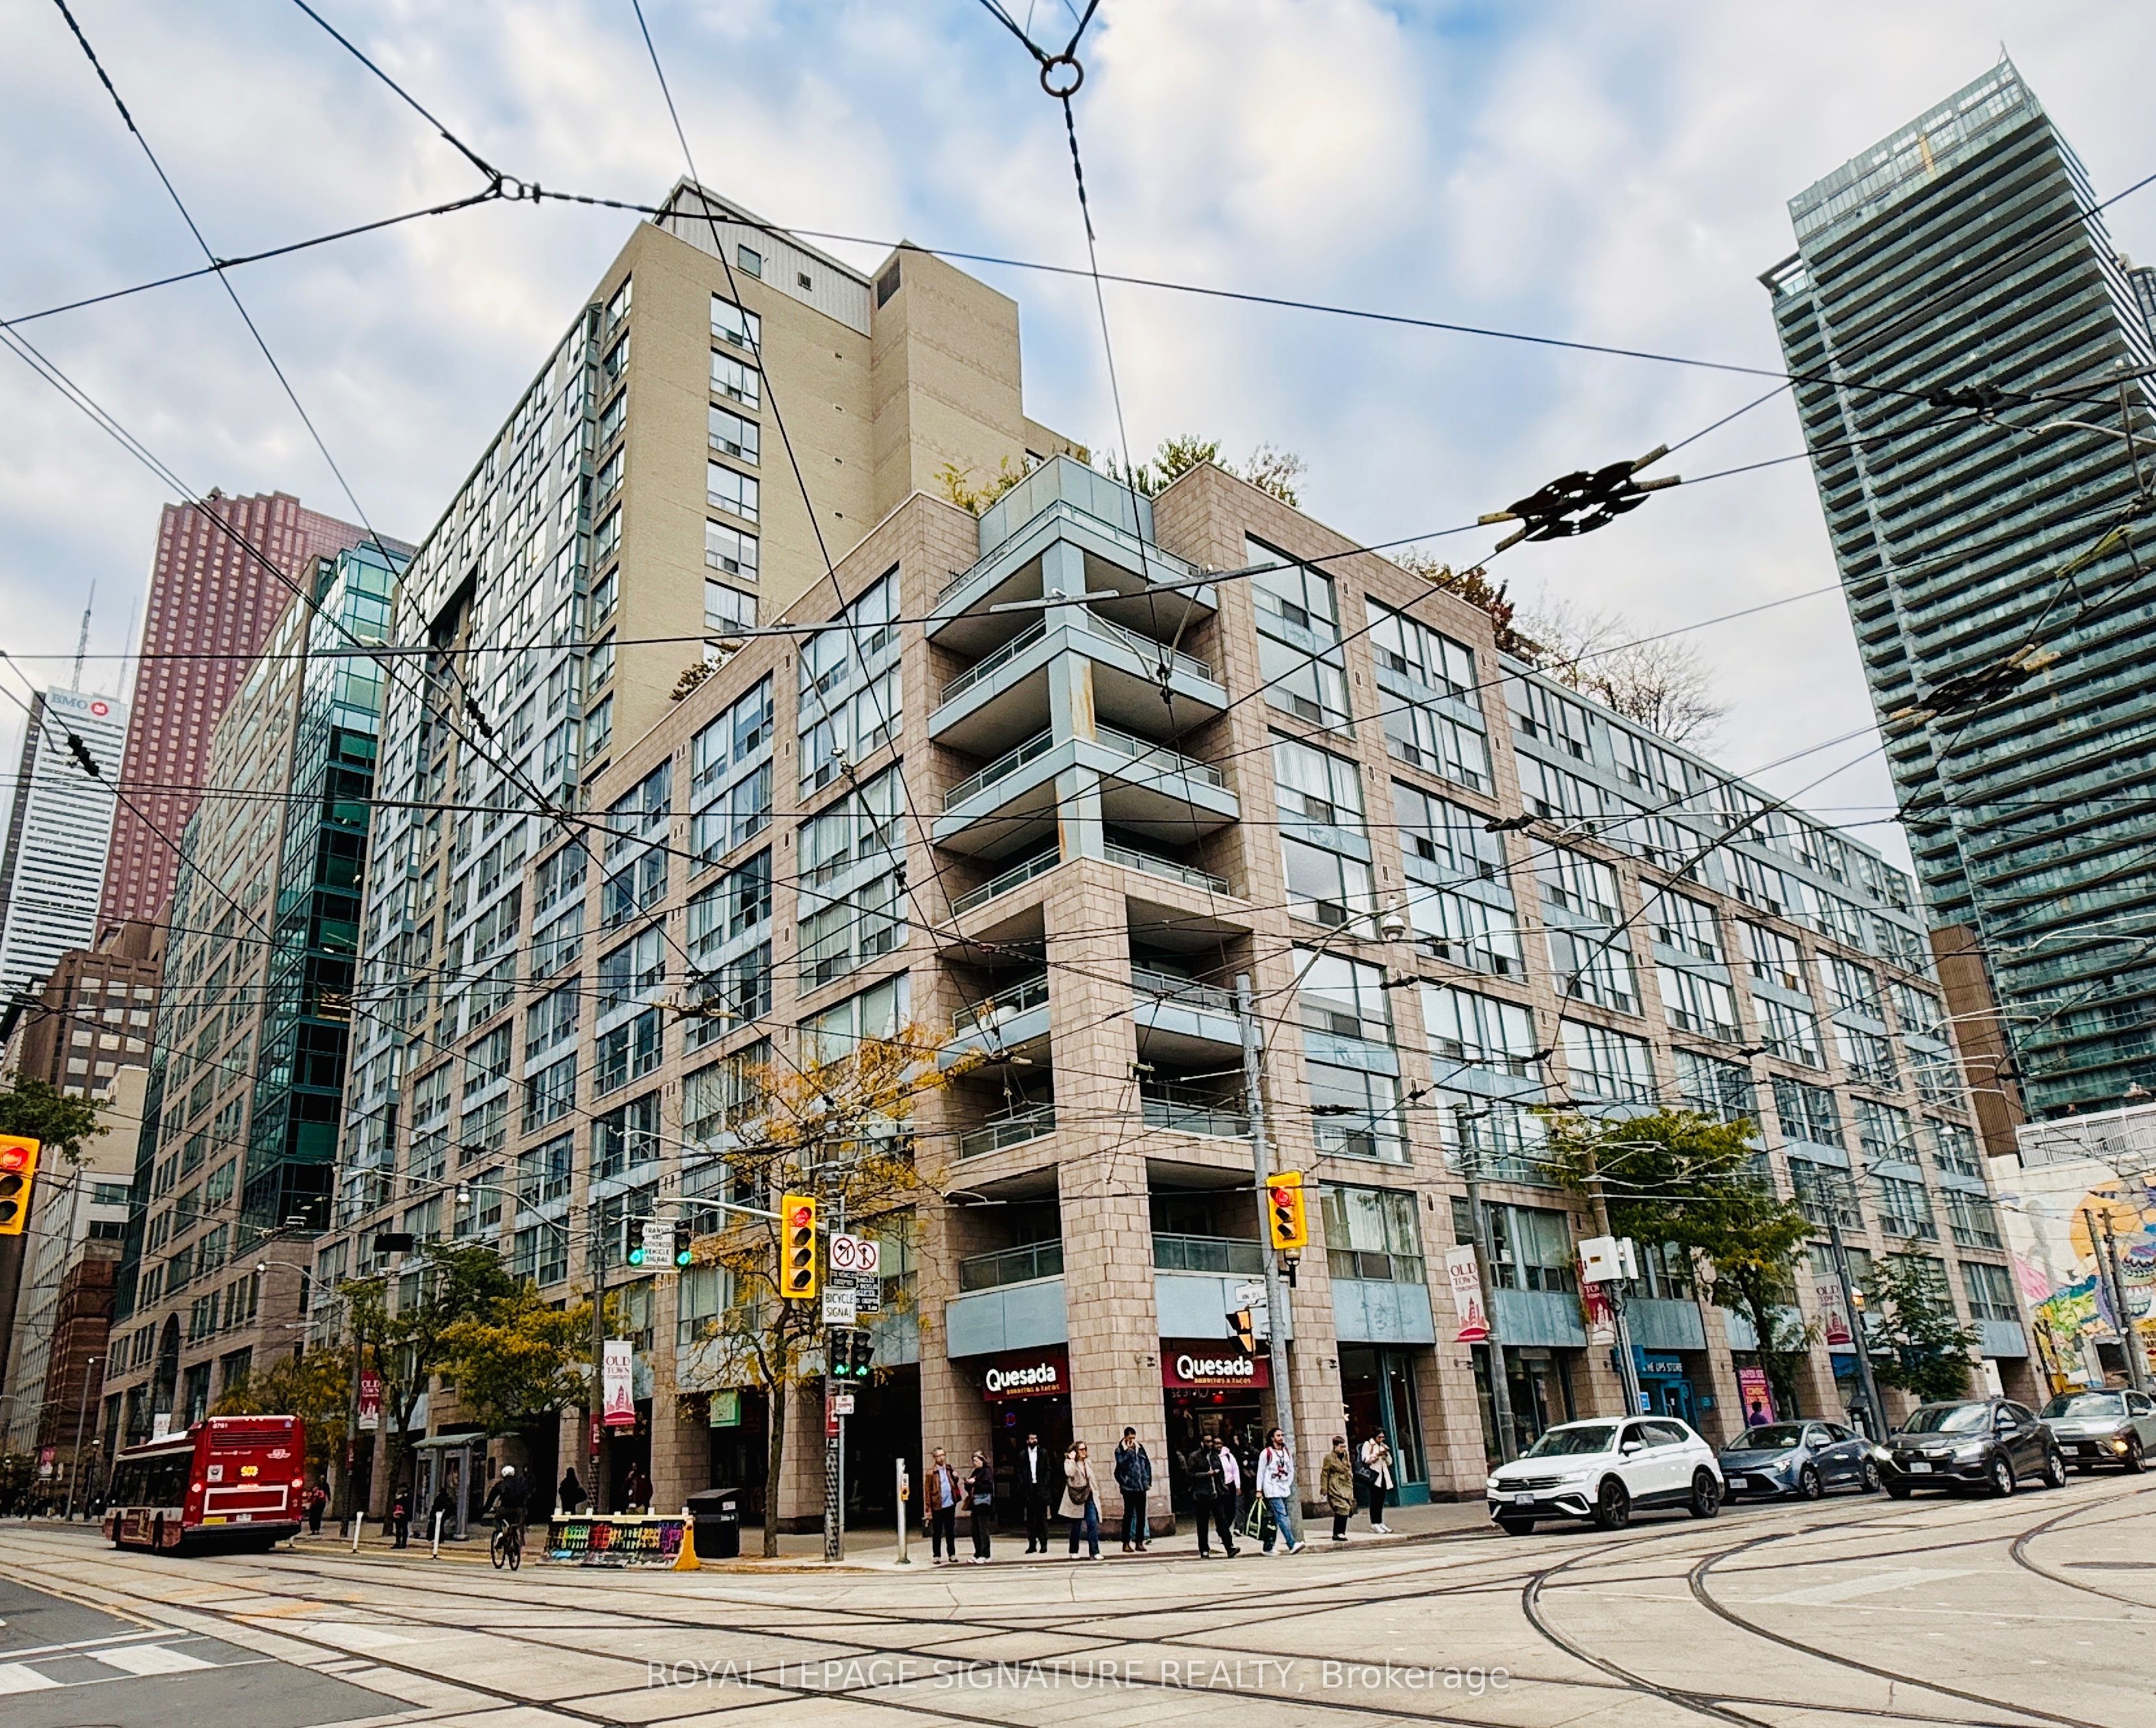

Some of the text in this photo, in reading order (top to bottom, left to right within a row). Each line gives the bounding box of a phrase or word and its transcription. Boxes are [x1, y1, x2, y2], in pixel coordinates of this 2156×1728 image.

[51, 693, 88, 710] BMO
[1451, 1263, 1476, 1277] OLD
[1816, 1285, 1839, 1296] OLD
[825, 1293, 854, 1304] BICYCLE
[826, 1307, 853, 1318] SIGNAL
[606, 1355, 631, 1366] OLD
[1177, 1355, 1254, 1379] Quesada
[986, 1363, 1056, 1391] Quesada
[362, 1380, 381, 1388] OLD
